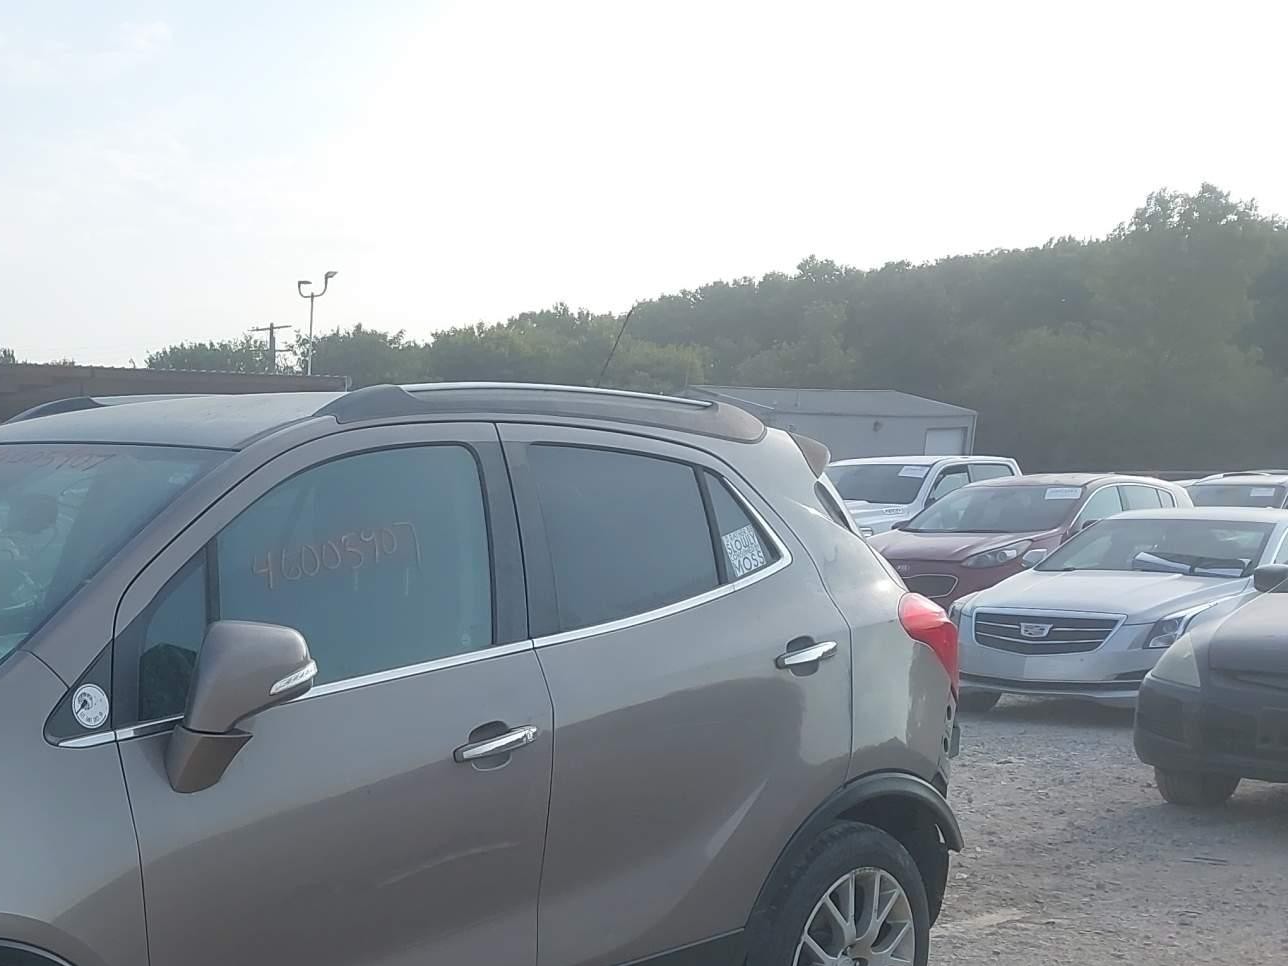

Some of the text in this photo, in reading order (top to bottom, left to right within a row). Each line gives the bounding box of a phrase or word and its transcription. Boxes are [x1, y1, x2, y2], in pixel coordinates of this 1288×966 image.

[252, 521, 422, 589] 46005907
[724, 532, 758, 555] SLOWLY
[732, 550, 765, 577] MOSS
